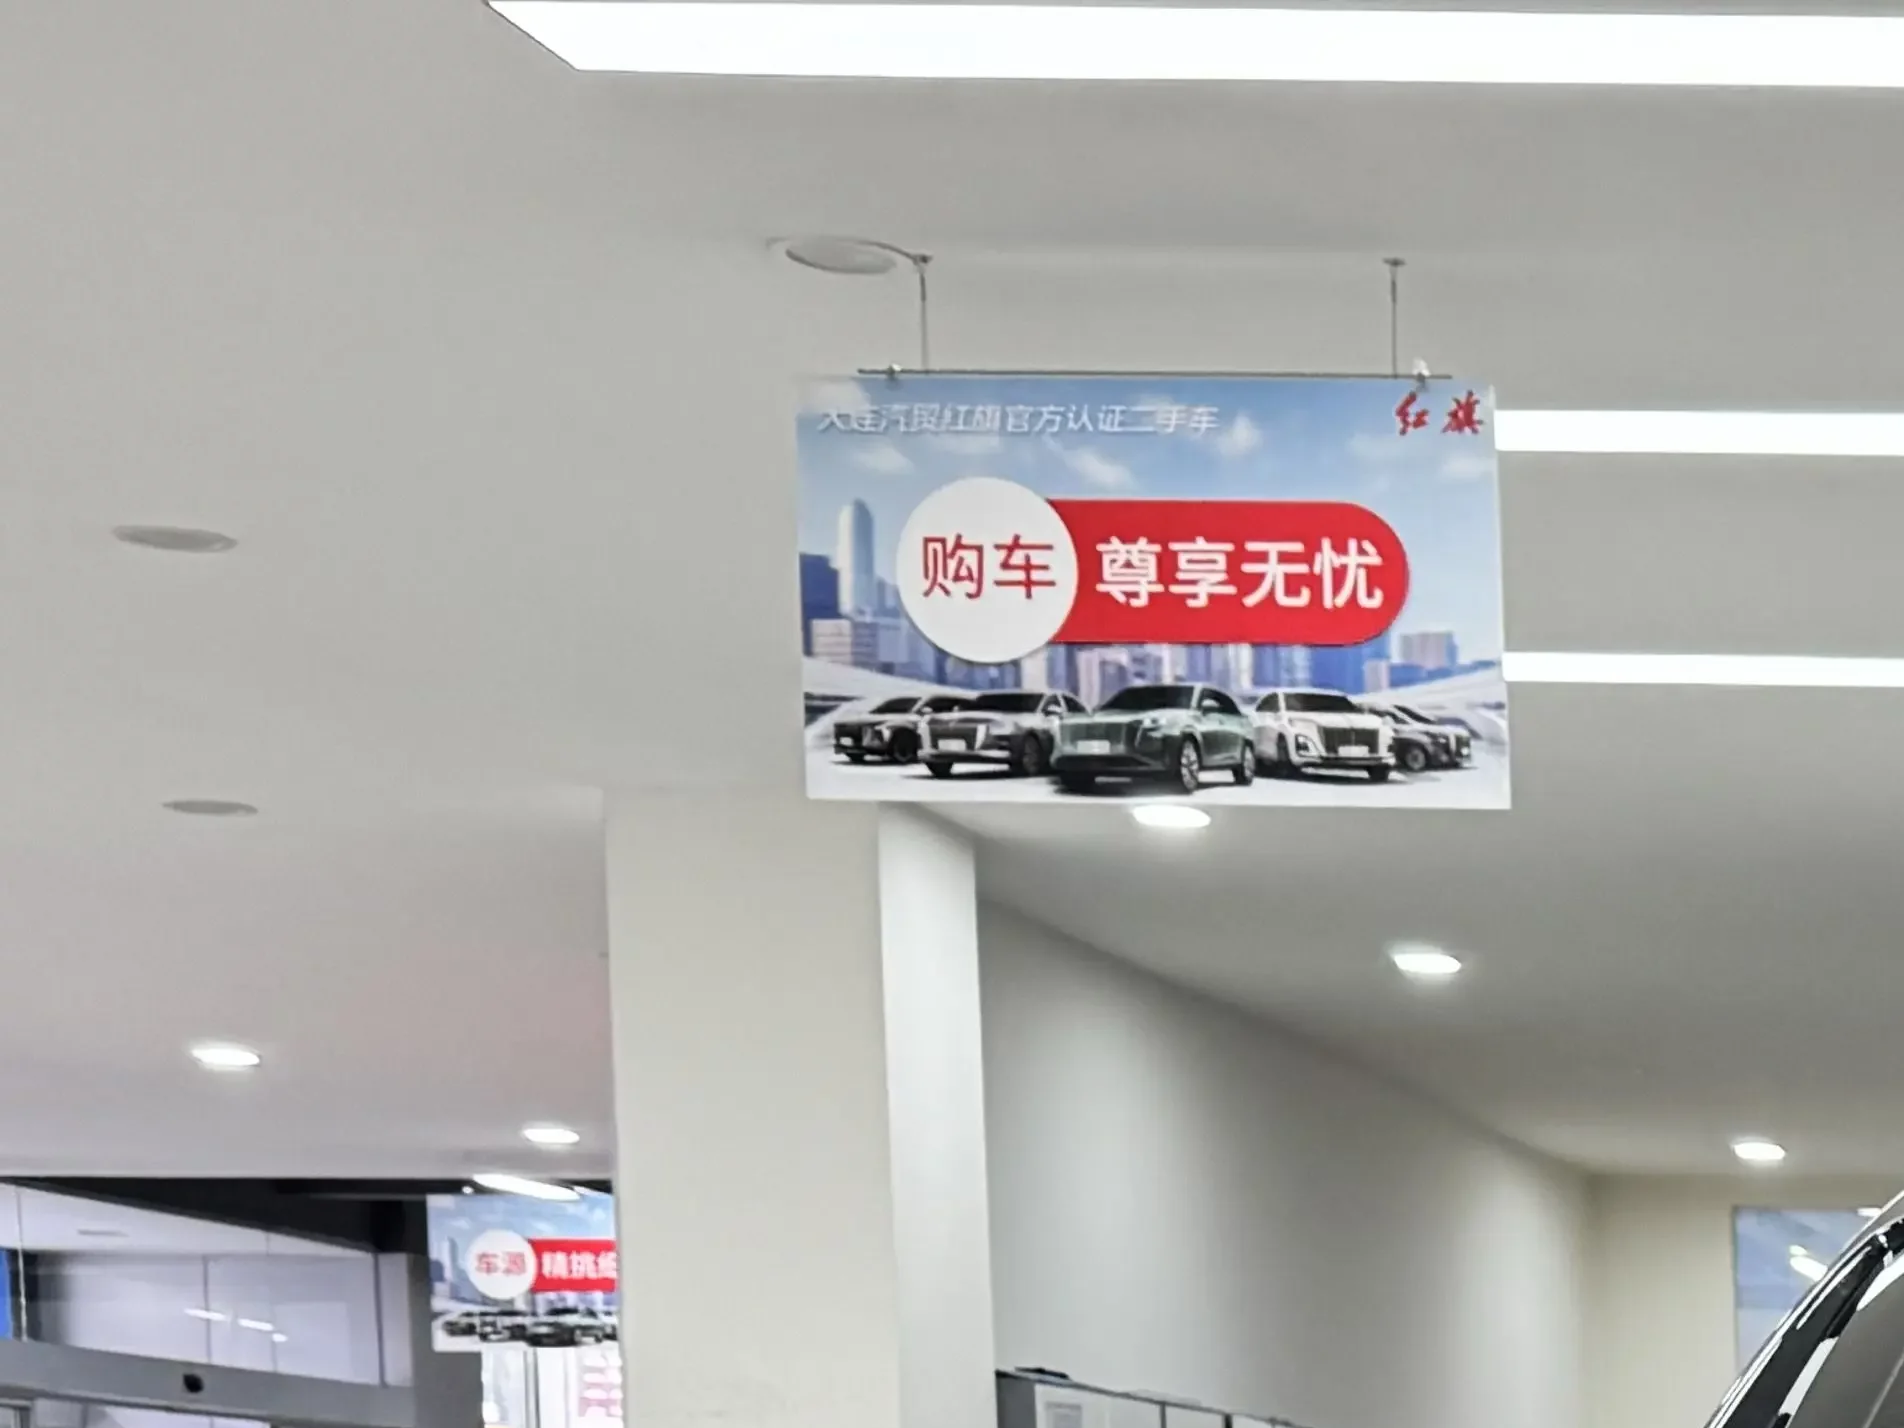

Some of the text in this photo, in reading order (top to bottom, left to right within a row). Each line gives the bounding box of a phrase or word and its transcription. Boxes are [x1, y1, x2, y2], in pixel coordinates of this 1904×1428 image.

[1394, 391, 1484, 437] 红旗
[920, 533, 1058, 601] 购车
[1095, 536, 1385, 610] 尊享无忧
